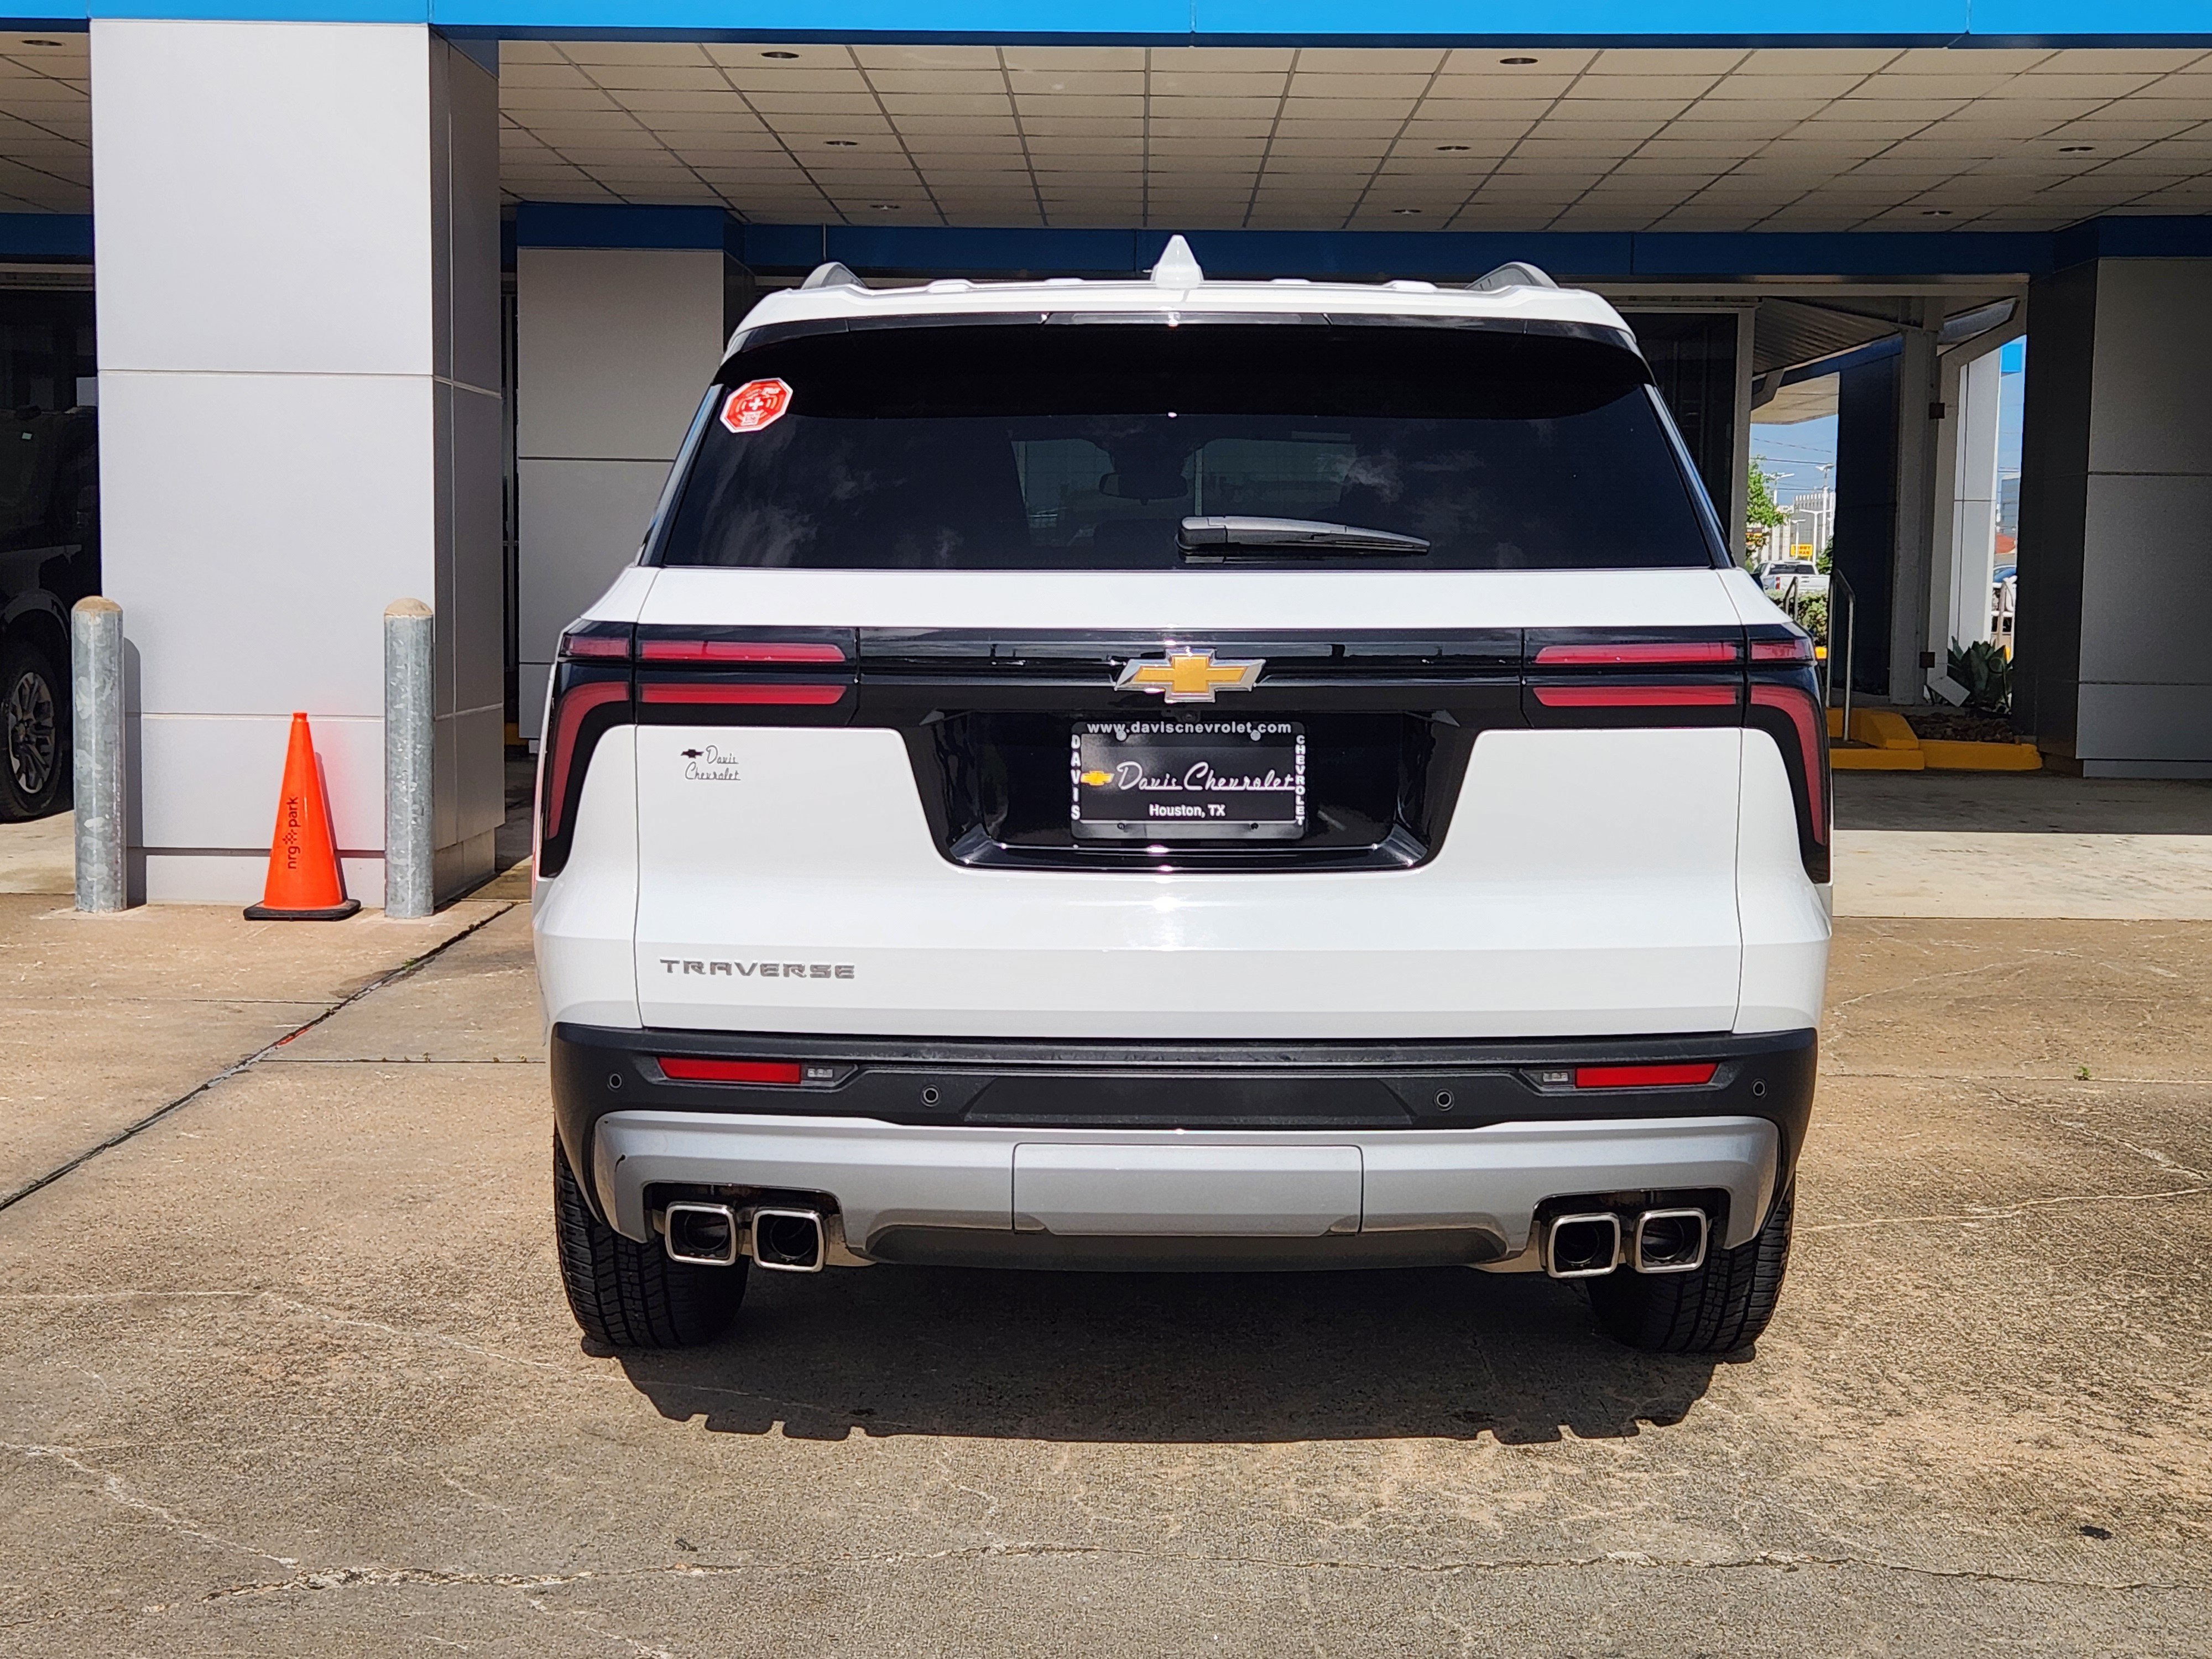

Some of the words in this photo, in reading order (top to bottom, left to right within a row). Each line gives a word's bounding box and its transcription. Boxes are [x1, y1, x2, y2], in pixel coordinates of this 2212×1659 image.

[705, 745, 739, 764] Davis
[685, 761, 742, 781] Chevrolet
[1070, 734, 1082, 820] DAVIS
[1116, 761, 1183, 791] Davis
[1183, 761, 1296, 791] Chevrolet
[1295, 734, 1306, 826] CHEVROLET
[286, 796, 301, 828] park
[1149, 804, 1206, 818] Houston,
[1207, 804, 1226, 817] TX
[288, 846, 301, 869] nrg
[660, 958, 855, 979] TRAVERSE
